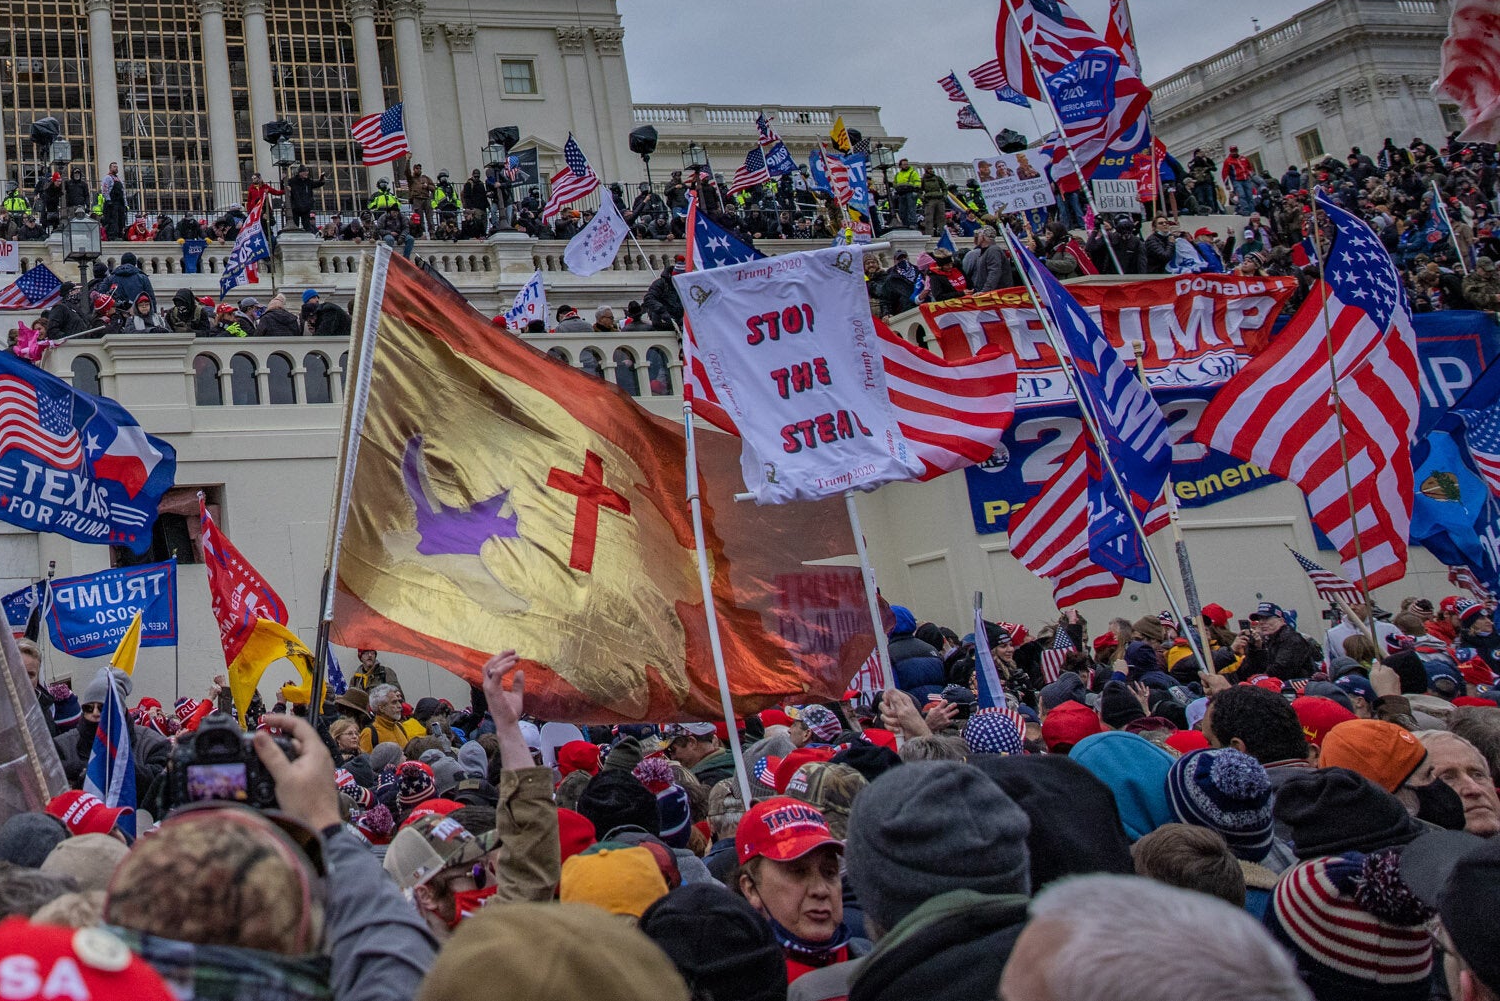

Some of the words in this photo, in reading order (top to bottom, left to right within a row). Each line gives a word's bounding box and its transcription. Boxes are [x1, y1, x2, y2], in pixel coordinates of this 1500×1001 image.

[1060, 101, 1085, 113] MERICA
[734, 264, 775, 282] Trump
[775, 257, 802, 273] 2020
[928, 290, 1043, 313] Re-Elec
[1174, 278, 1266, 297] Donald
[852, 319, 866, 349] 2020
[933, 294, 1278, 363] TRUMP
[770, 357, 832, 400] THE
[861, 351, 876, 391] Trump
[780, 409, 874, 454] STEAL
[20, 459, 111, 520] TEXAS
[814, 468, 853, 490] Trump
[851, 462, 877, 480] 2020
[7, 496, 55, 525] FOR
[55, 510, 111, 538] TRUMP
[61, 800, 80, 823] MAKE
